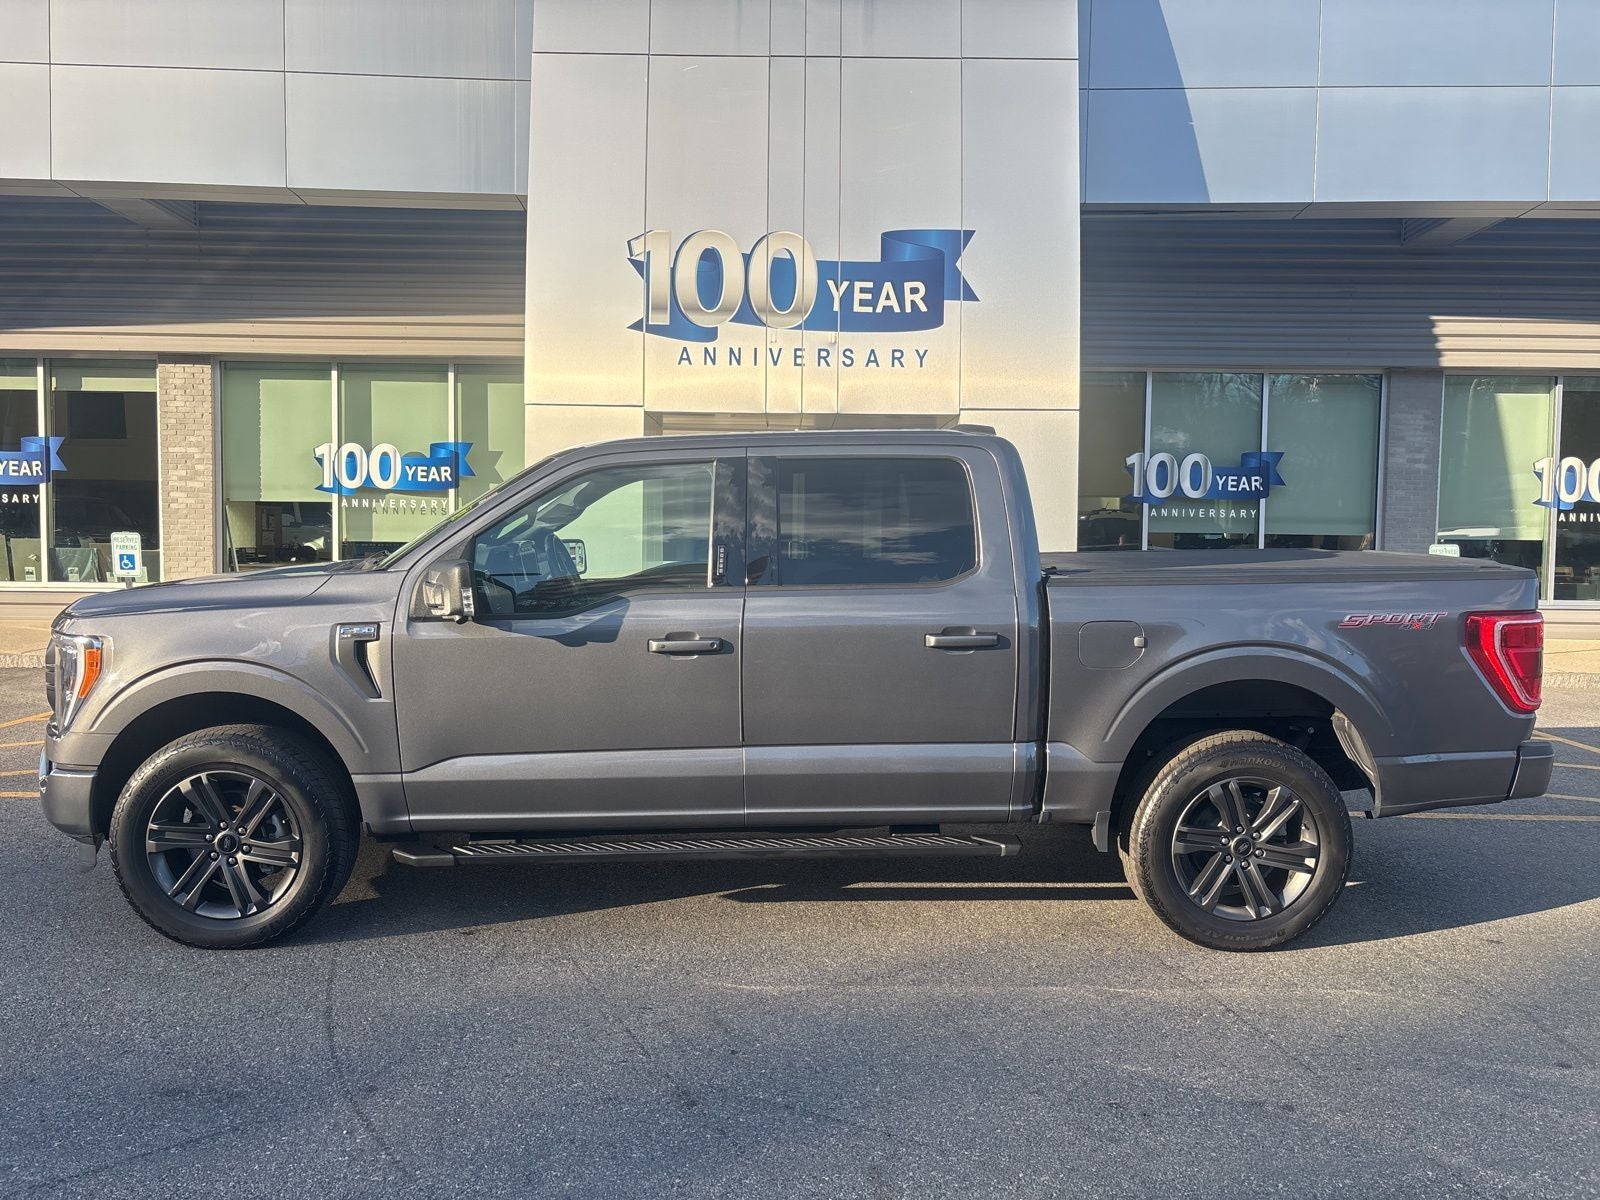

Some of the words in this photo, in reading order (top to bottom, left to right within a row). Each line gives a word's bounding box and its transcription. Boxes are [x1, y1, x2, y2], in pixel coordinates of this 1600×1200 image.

[626, 229, 819, 330] 100
[827, 279, 928, 313] YEAR
[677, 346, 929, 368] ANNIVERSARY
[0, 460, 43, 477] YEAR
[314, 442, 402, 490] 100
[405, 465, 453, 482] YEAR
[1125, 452, 1213, 499] 100
[1216, 475, 1264, 492] YEAR
[341, 498, 449, 509] ANNIVERSARY
[1150, 508, 1258, 519] ANNIVERSARY
[1338, 611, 1448, 629] SPORT
